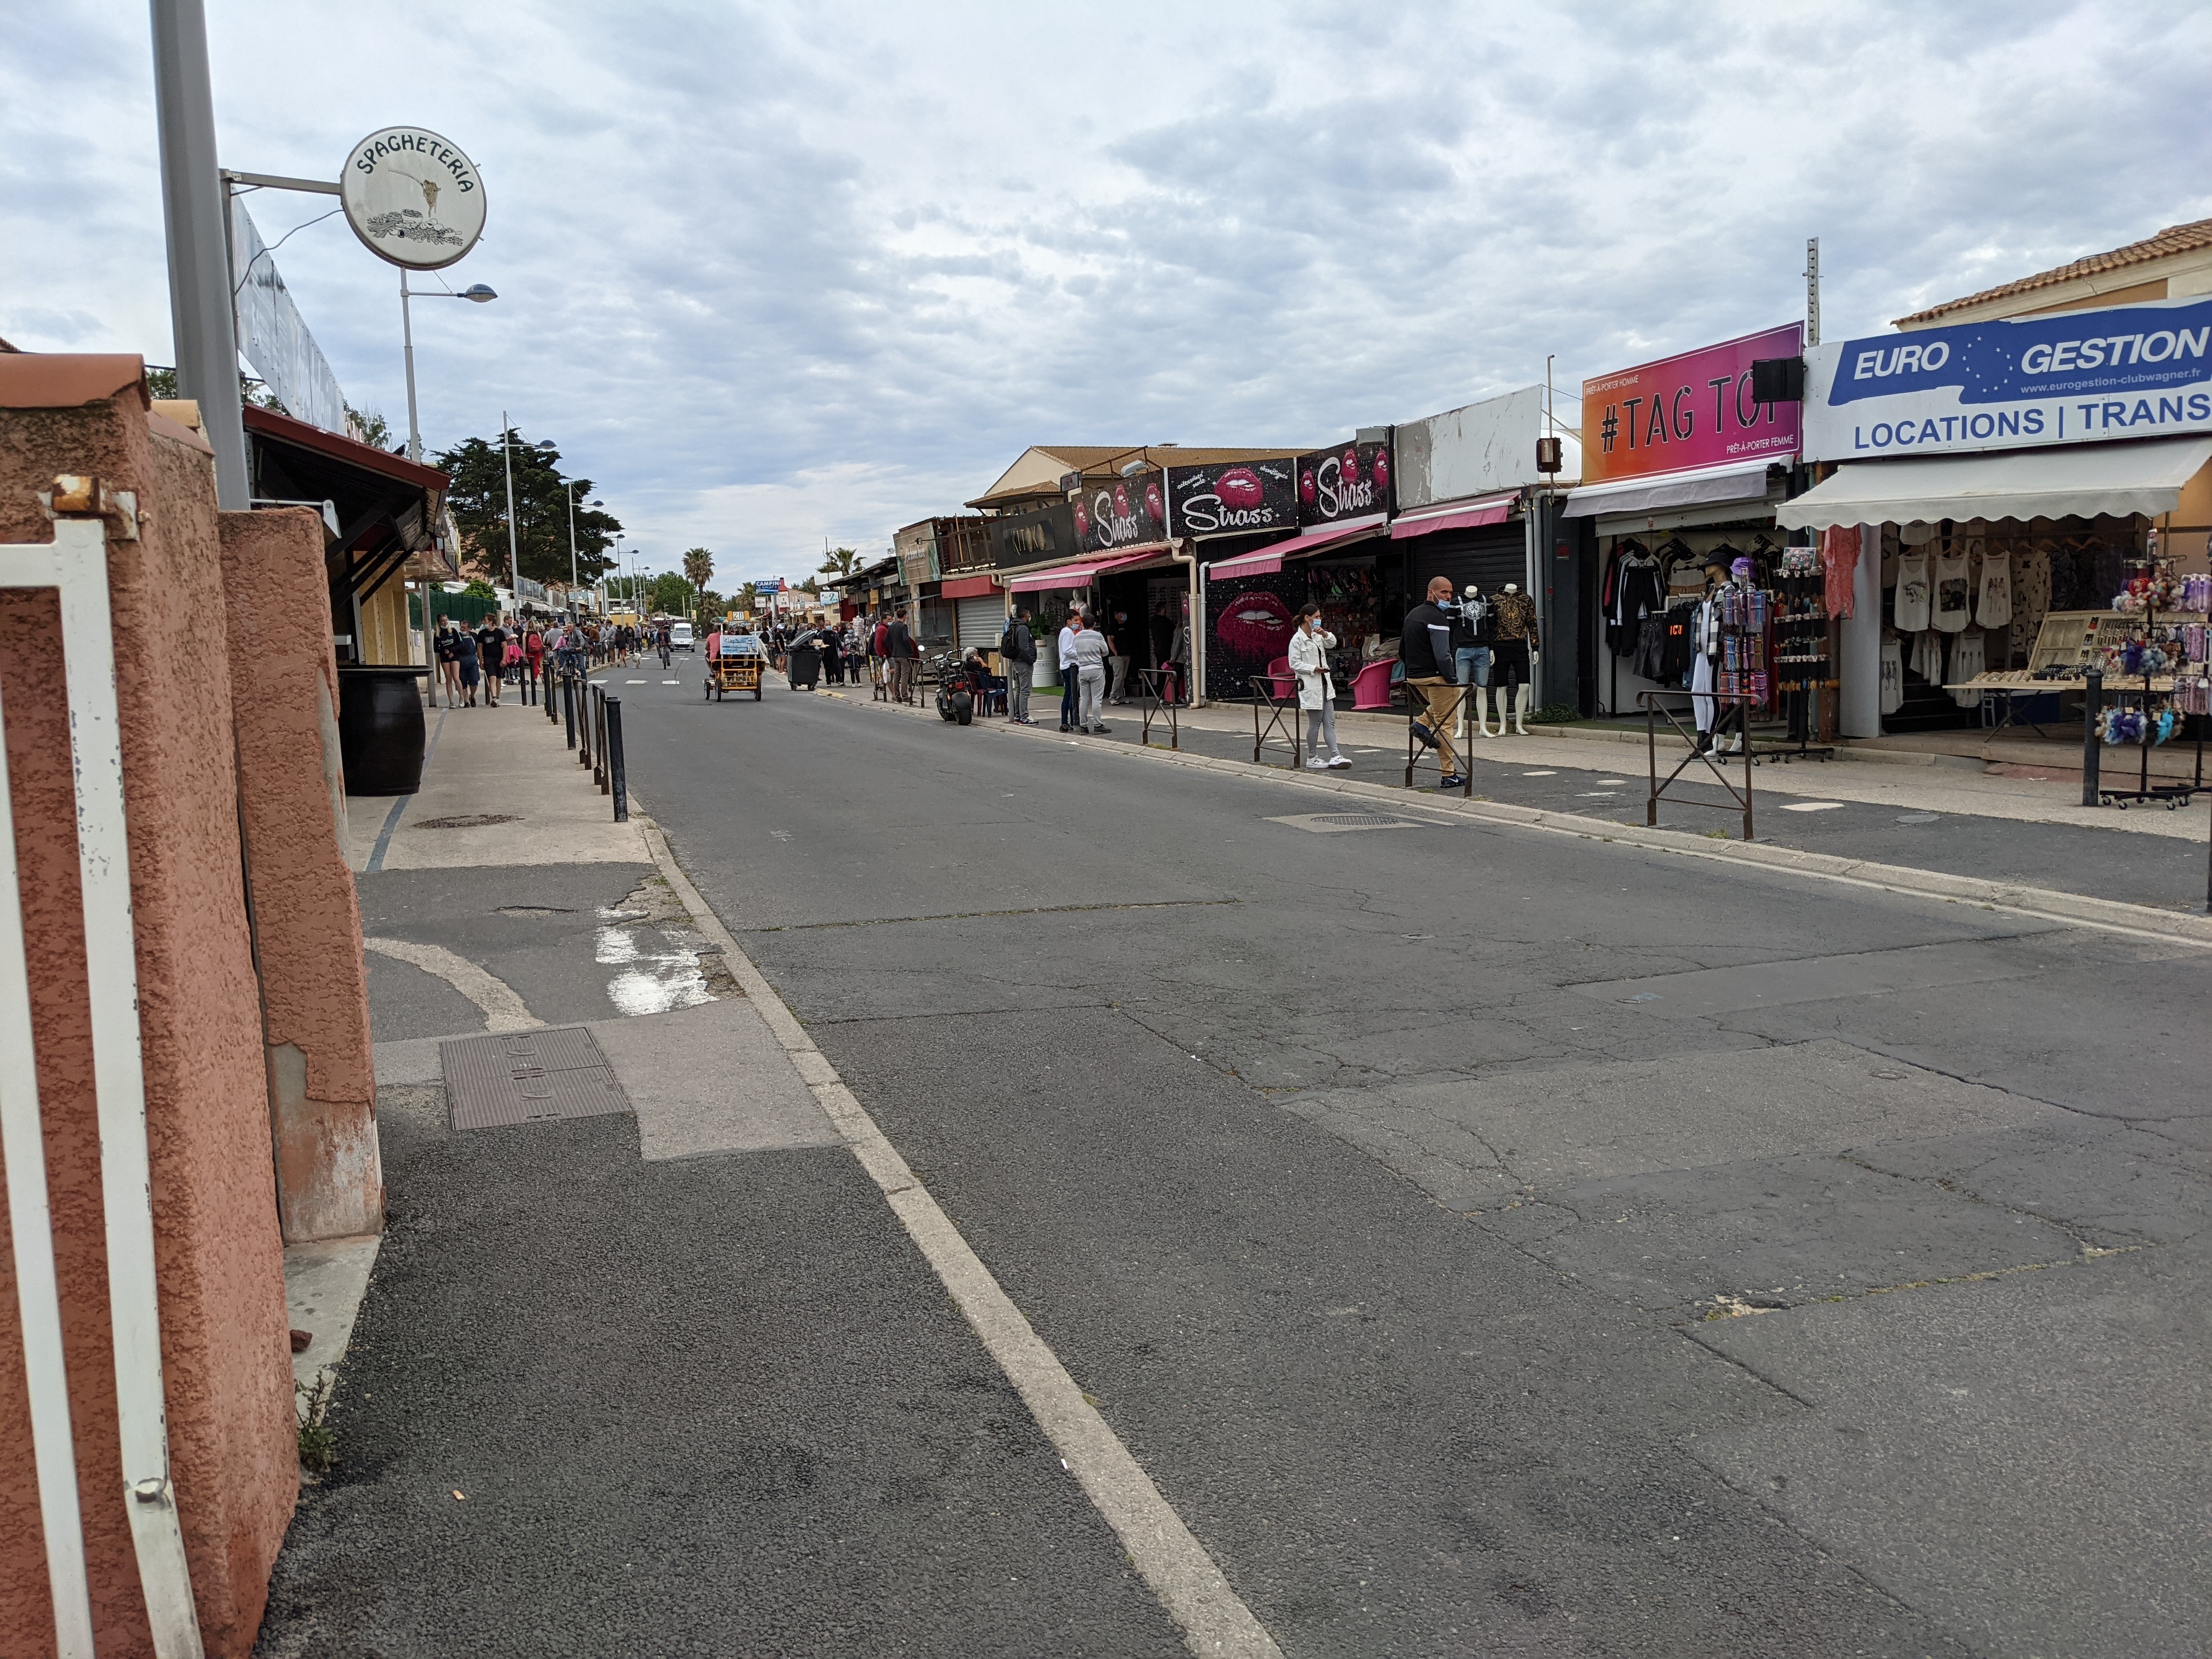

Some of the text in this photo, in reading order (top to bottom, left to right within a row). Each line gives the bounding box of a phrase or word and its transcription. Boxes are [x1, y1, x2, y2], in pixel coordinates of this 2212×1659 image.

[357, 134, 474, 193] SPAGHETERIA
[1854, 326, 2211, 380] EURO GESTION
[1619, 375, 1639, 387] HOMME
[2020, 368, 2202, 393] www.eurogestion-clubwagner.fr
[1600, 385, 1694, 454] #TAG
[1726, 434, 1794, 454] PRÊT-À-PORTER FEMME
[1855, 393, 2211, 450] LOCATIONS TRANS
[1192, 478, 1206, 488] mode
[1318, 456, 1372, 518] Strass
[1094, 490, 1138, 547] Strass
[1182, 494, 1274, 531] Strass
